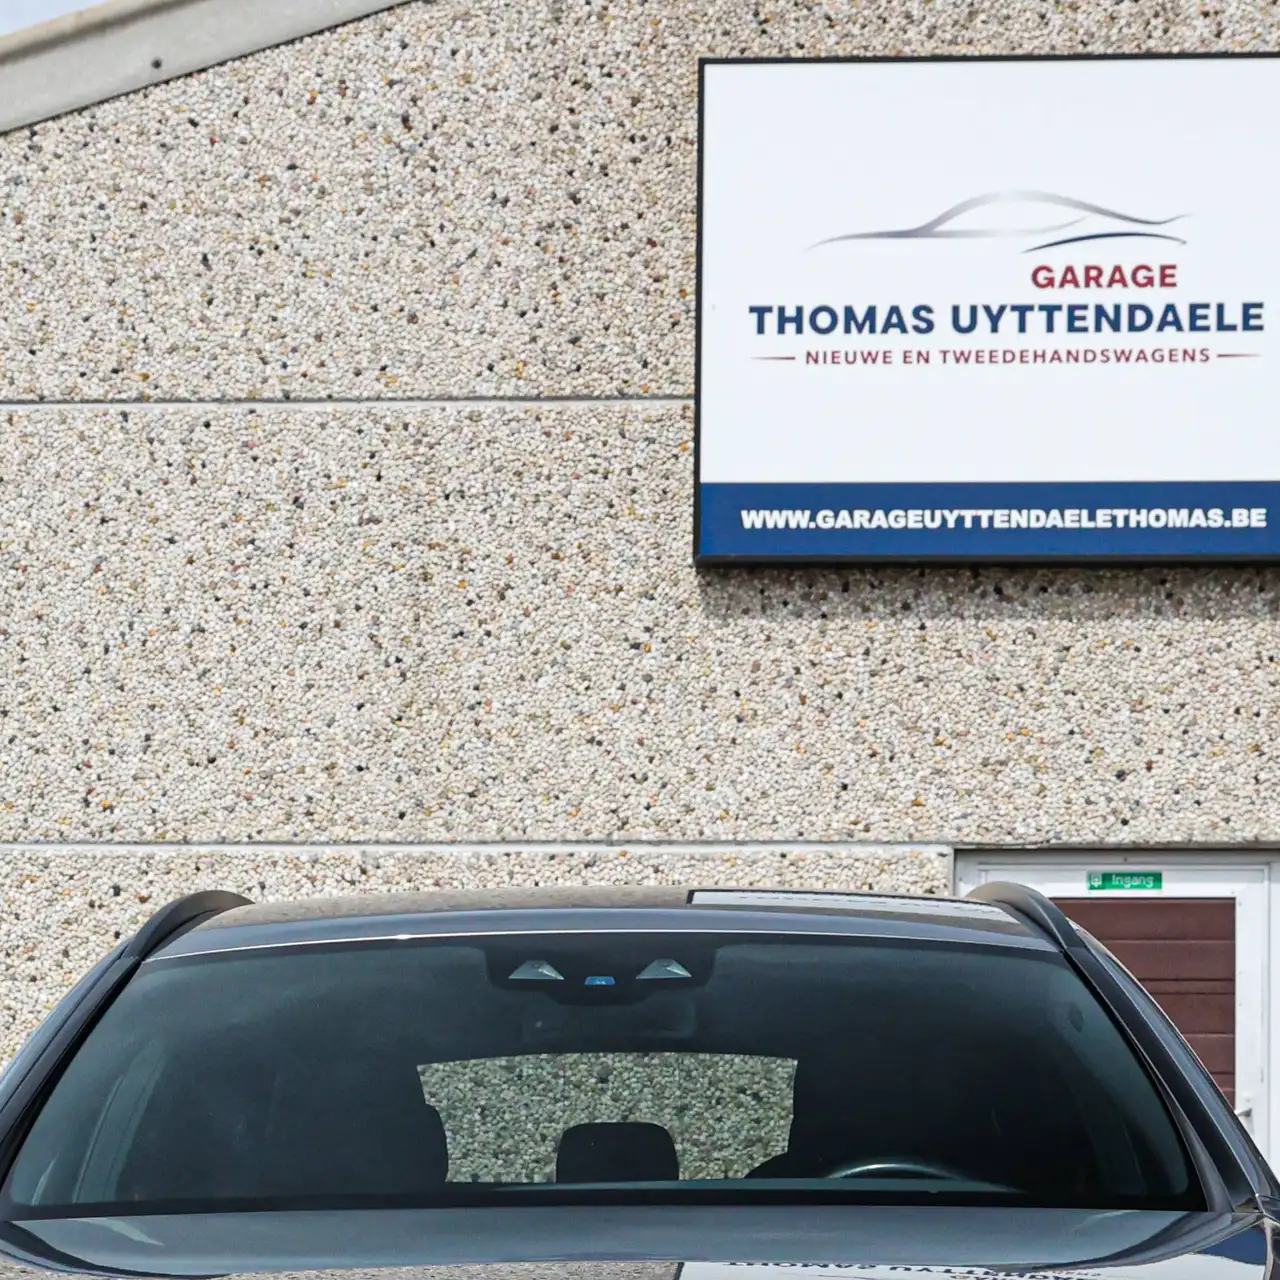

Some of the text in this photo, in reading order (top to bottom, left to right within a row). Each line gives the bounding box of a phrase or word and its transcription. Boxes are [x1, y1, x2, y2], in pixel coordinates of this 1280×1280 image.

[1031, 264, 1177, 289] GARAGE
[748, 301, 1266, 335] THOMAS UYTTENDAELE
[805, 347, 1211, 365] NIEUWE EN TWEEDEHANDSWAGENS
[740, 508, 1268, 530] WWW.GARAGEUYTTENDAELETHOMAS.BE
